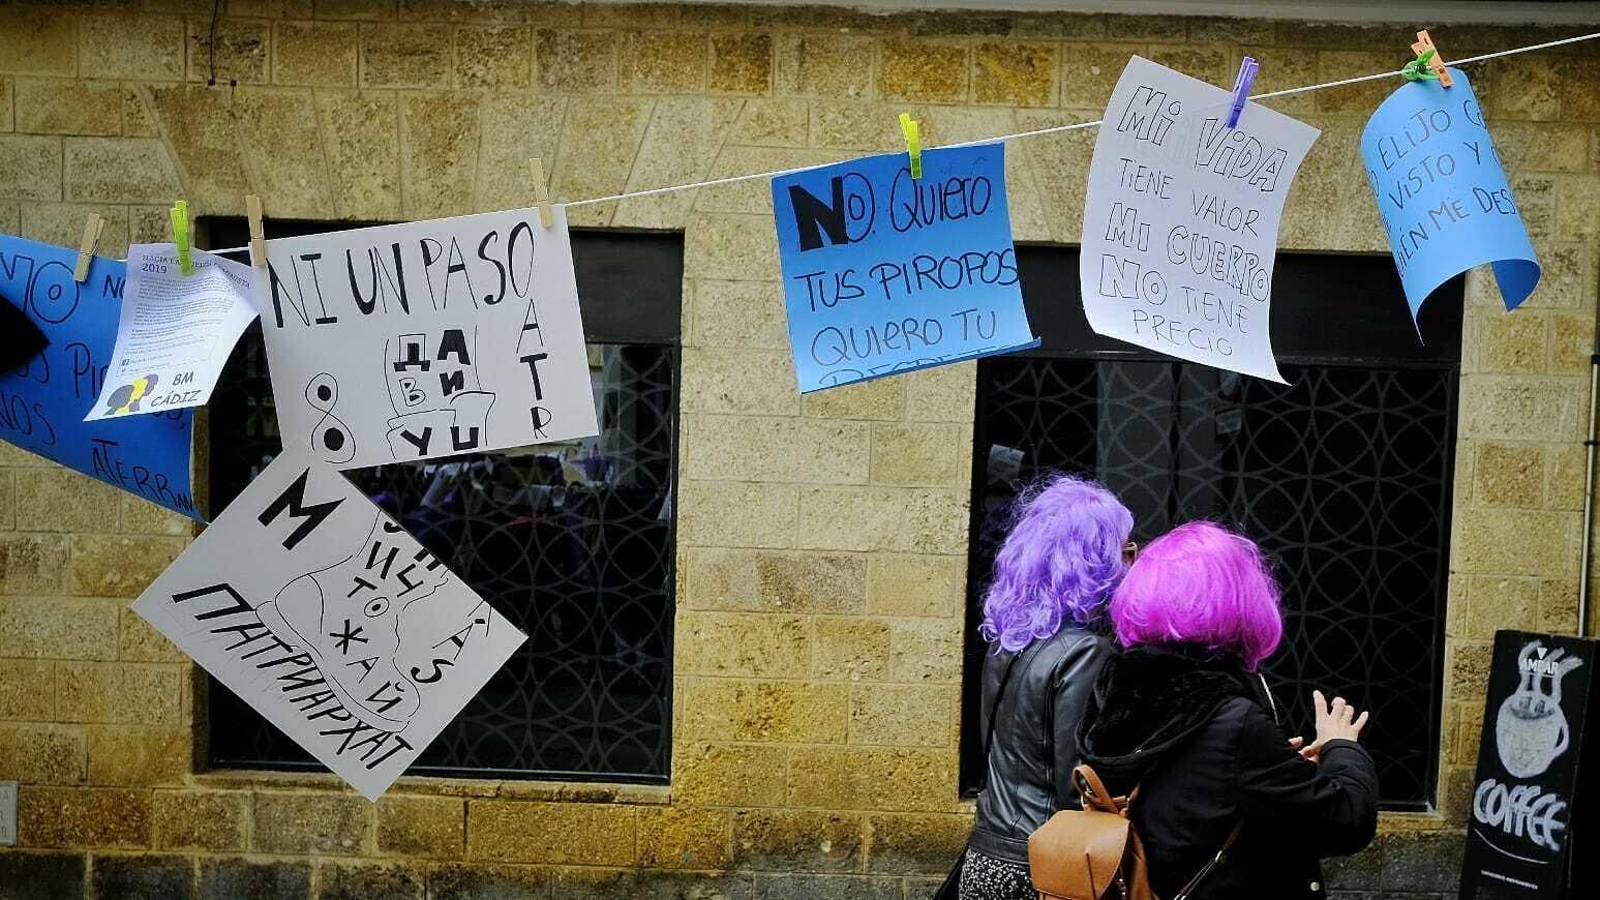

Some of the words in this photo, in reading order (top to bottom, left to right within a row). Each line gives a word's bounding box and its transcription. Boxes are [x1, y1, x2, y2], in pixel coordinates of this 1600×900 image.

[1462, 141, 1480, 166] Y
[1192, 189, 1260, 238] VALOR
[1428, 199, 1470, 231] ME
[141, 262, 168, 275] 2019
[265, 253, 338, 328] NI
[346, 242, 411, 316] UN
[420, 221, 535, 312] PASO
[794, 270, 865, 312] TUS
[869, 248, 1019, 300] PIROPOS
[1099, 254, 1168, 305] NO
[1167, 225, 1269, 301] CUERPO
[952, 308, 996, 340] TU
[150, 390, 201, 408] CÁDIZ
[172, 582, 416, 770] ПАТРИАРХАТ
[1473, 778, 1568, 852] COFFEE
